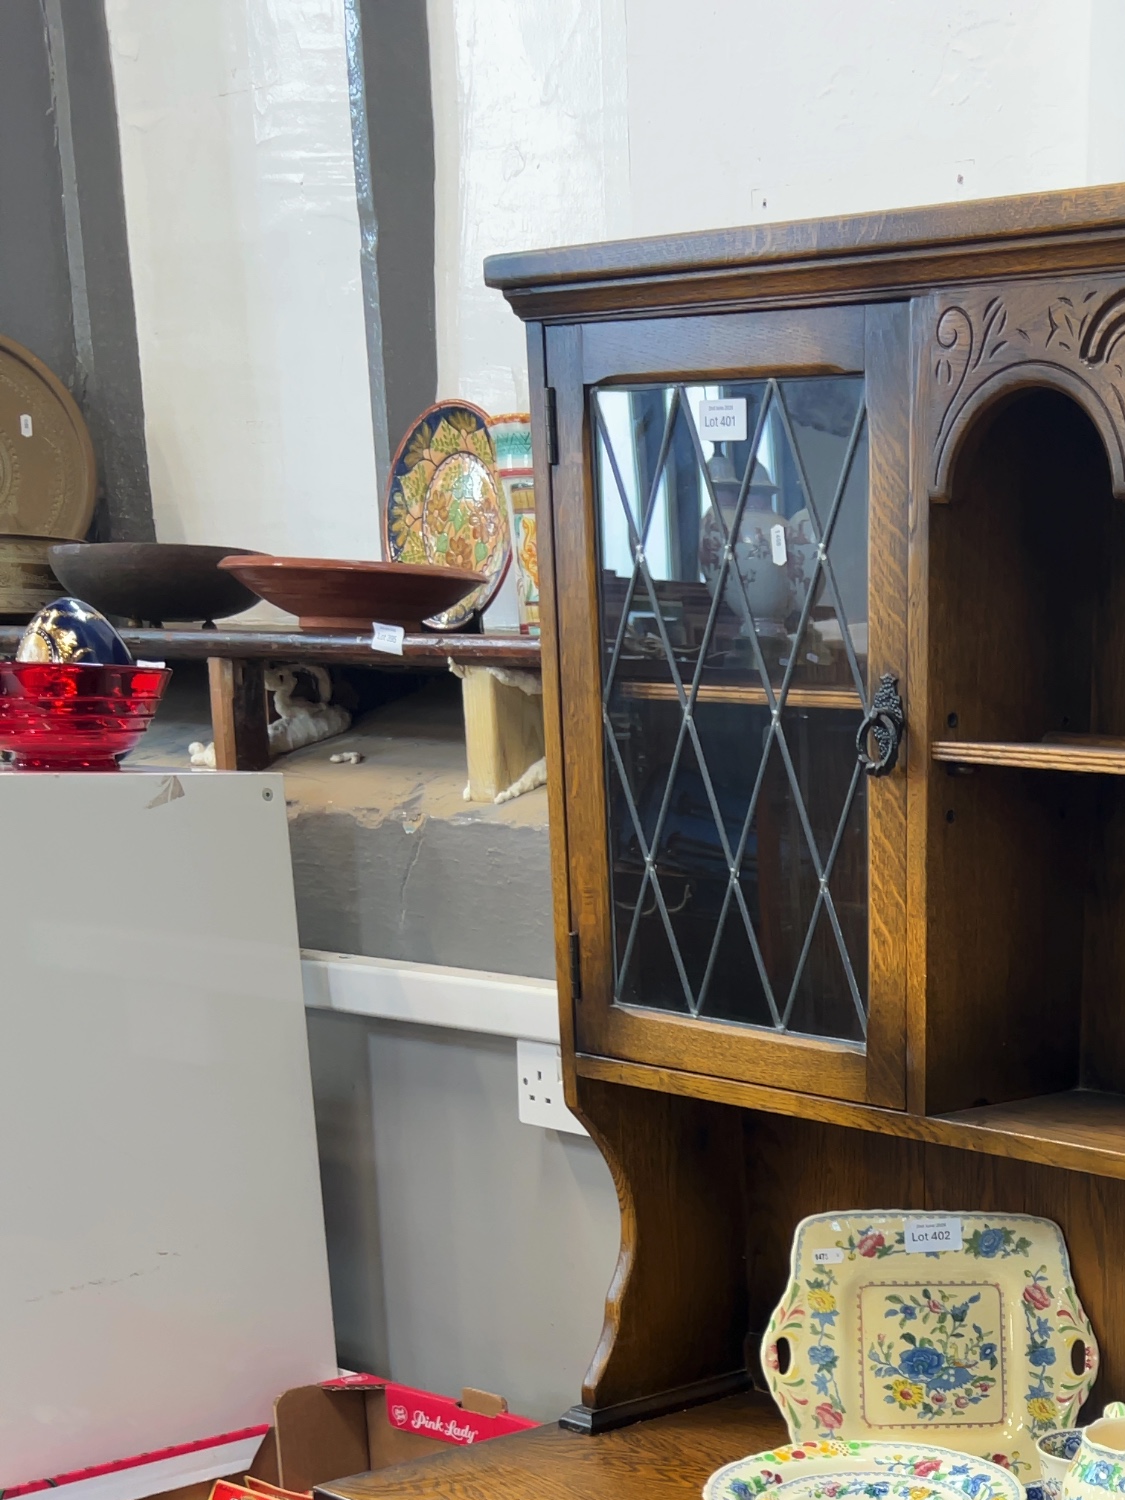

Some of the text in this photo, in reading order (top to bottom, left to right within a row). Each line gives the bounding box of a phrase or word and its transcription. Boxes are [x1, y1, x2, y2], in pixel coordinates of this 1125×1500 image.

[704, 415, 736, 428] Lot 401
[911, 1230, 951, 1242] Lot 402
[411, 1410, 444, 1432] Pink
[444, 1420, 476, 1444] Lady
